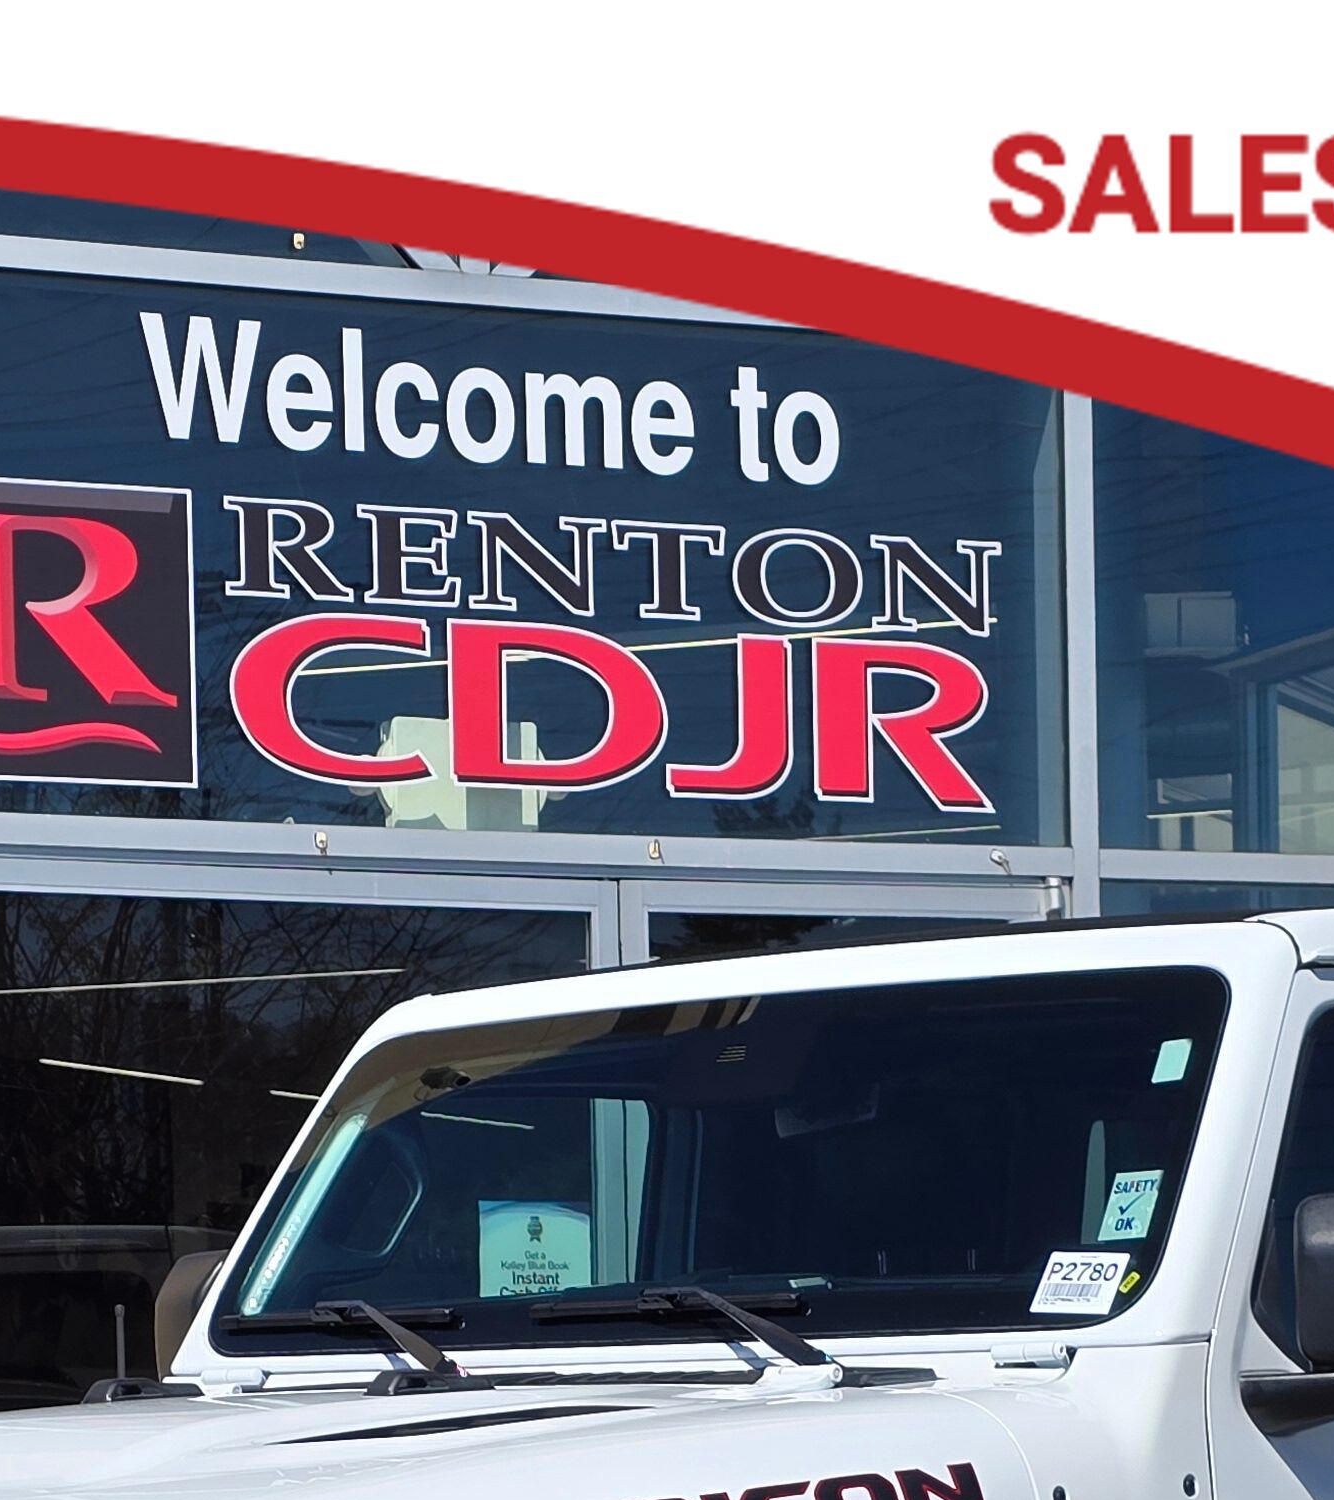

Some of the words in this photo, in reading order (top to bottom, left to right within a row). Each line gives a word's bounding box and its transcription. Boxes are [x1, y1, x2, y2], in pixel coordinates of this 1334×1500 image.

[139, 311, 695, 482] Welcome
[731, 367, 839, 484] to
[224, 494, 1002, 637] RENTON
[229, 613, 996, 813] CDJR
[1114, 1178, 1158, 1194] SAFETY
[1114, 1217, 1135, 1231] OK
[512, 1271, 560, 1285] Instant
[1047, 1262, 1118, 1281] P2780
